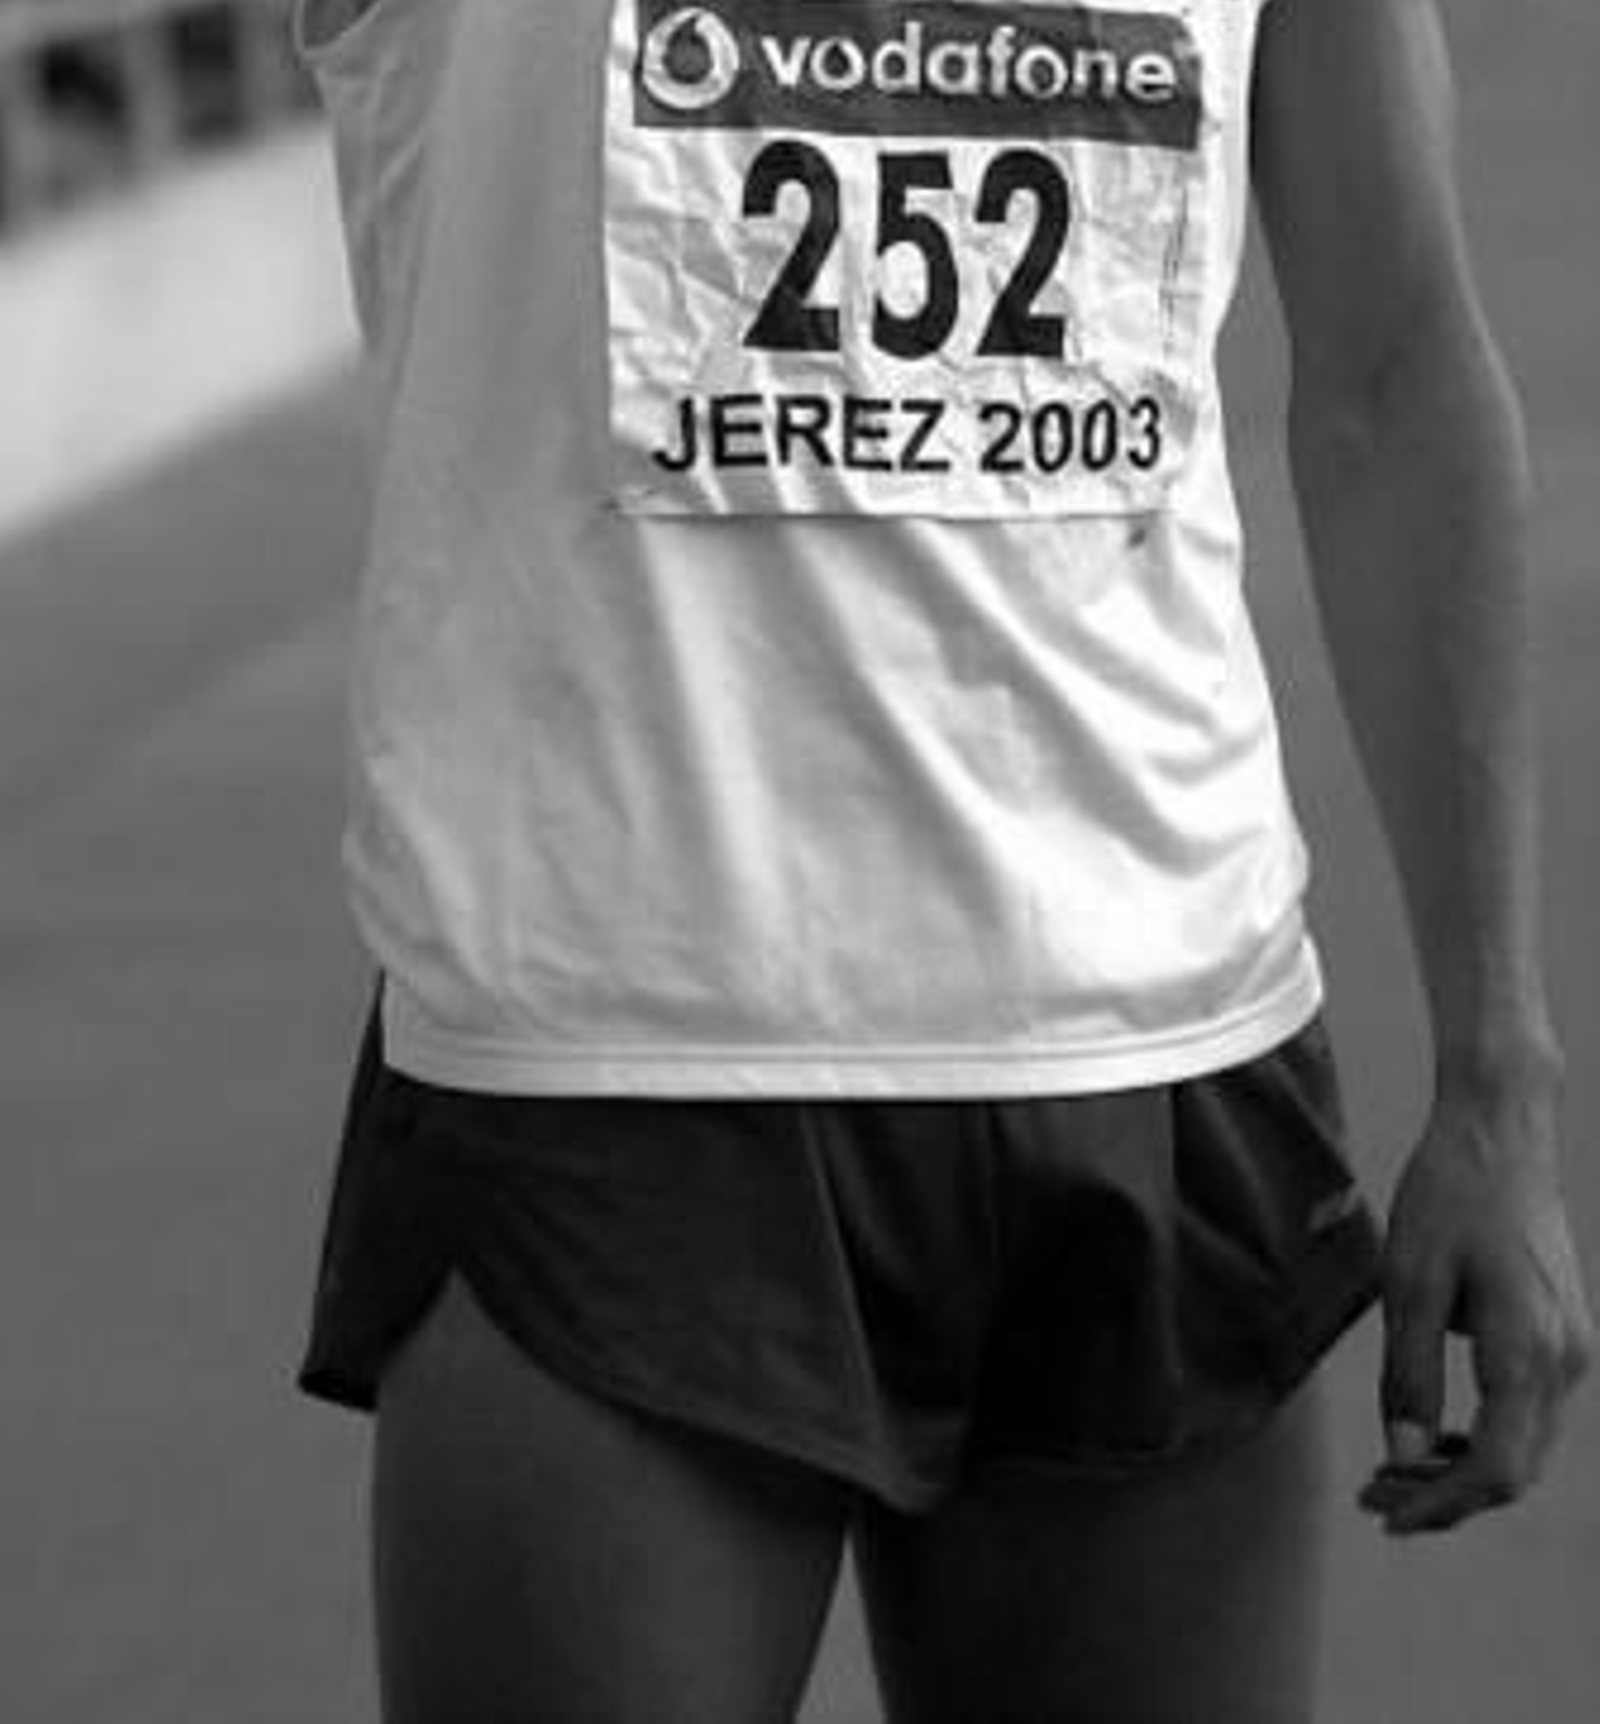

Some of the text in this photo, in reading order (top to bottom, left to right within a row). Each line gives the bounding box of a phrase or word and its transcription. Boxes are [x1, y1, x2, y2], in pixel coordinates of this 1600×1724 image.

[761, 21, 1177, 104] vodafone
[741, 139, 1071, 360] 252
[653, 393, 1162, 475] JEREZ 2003
